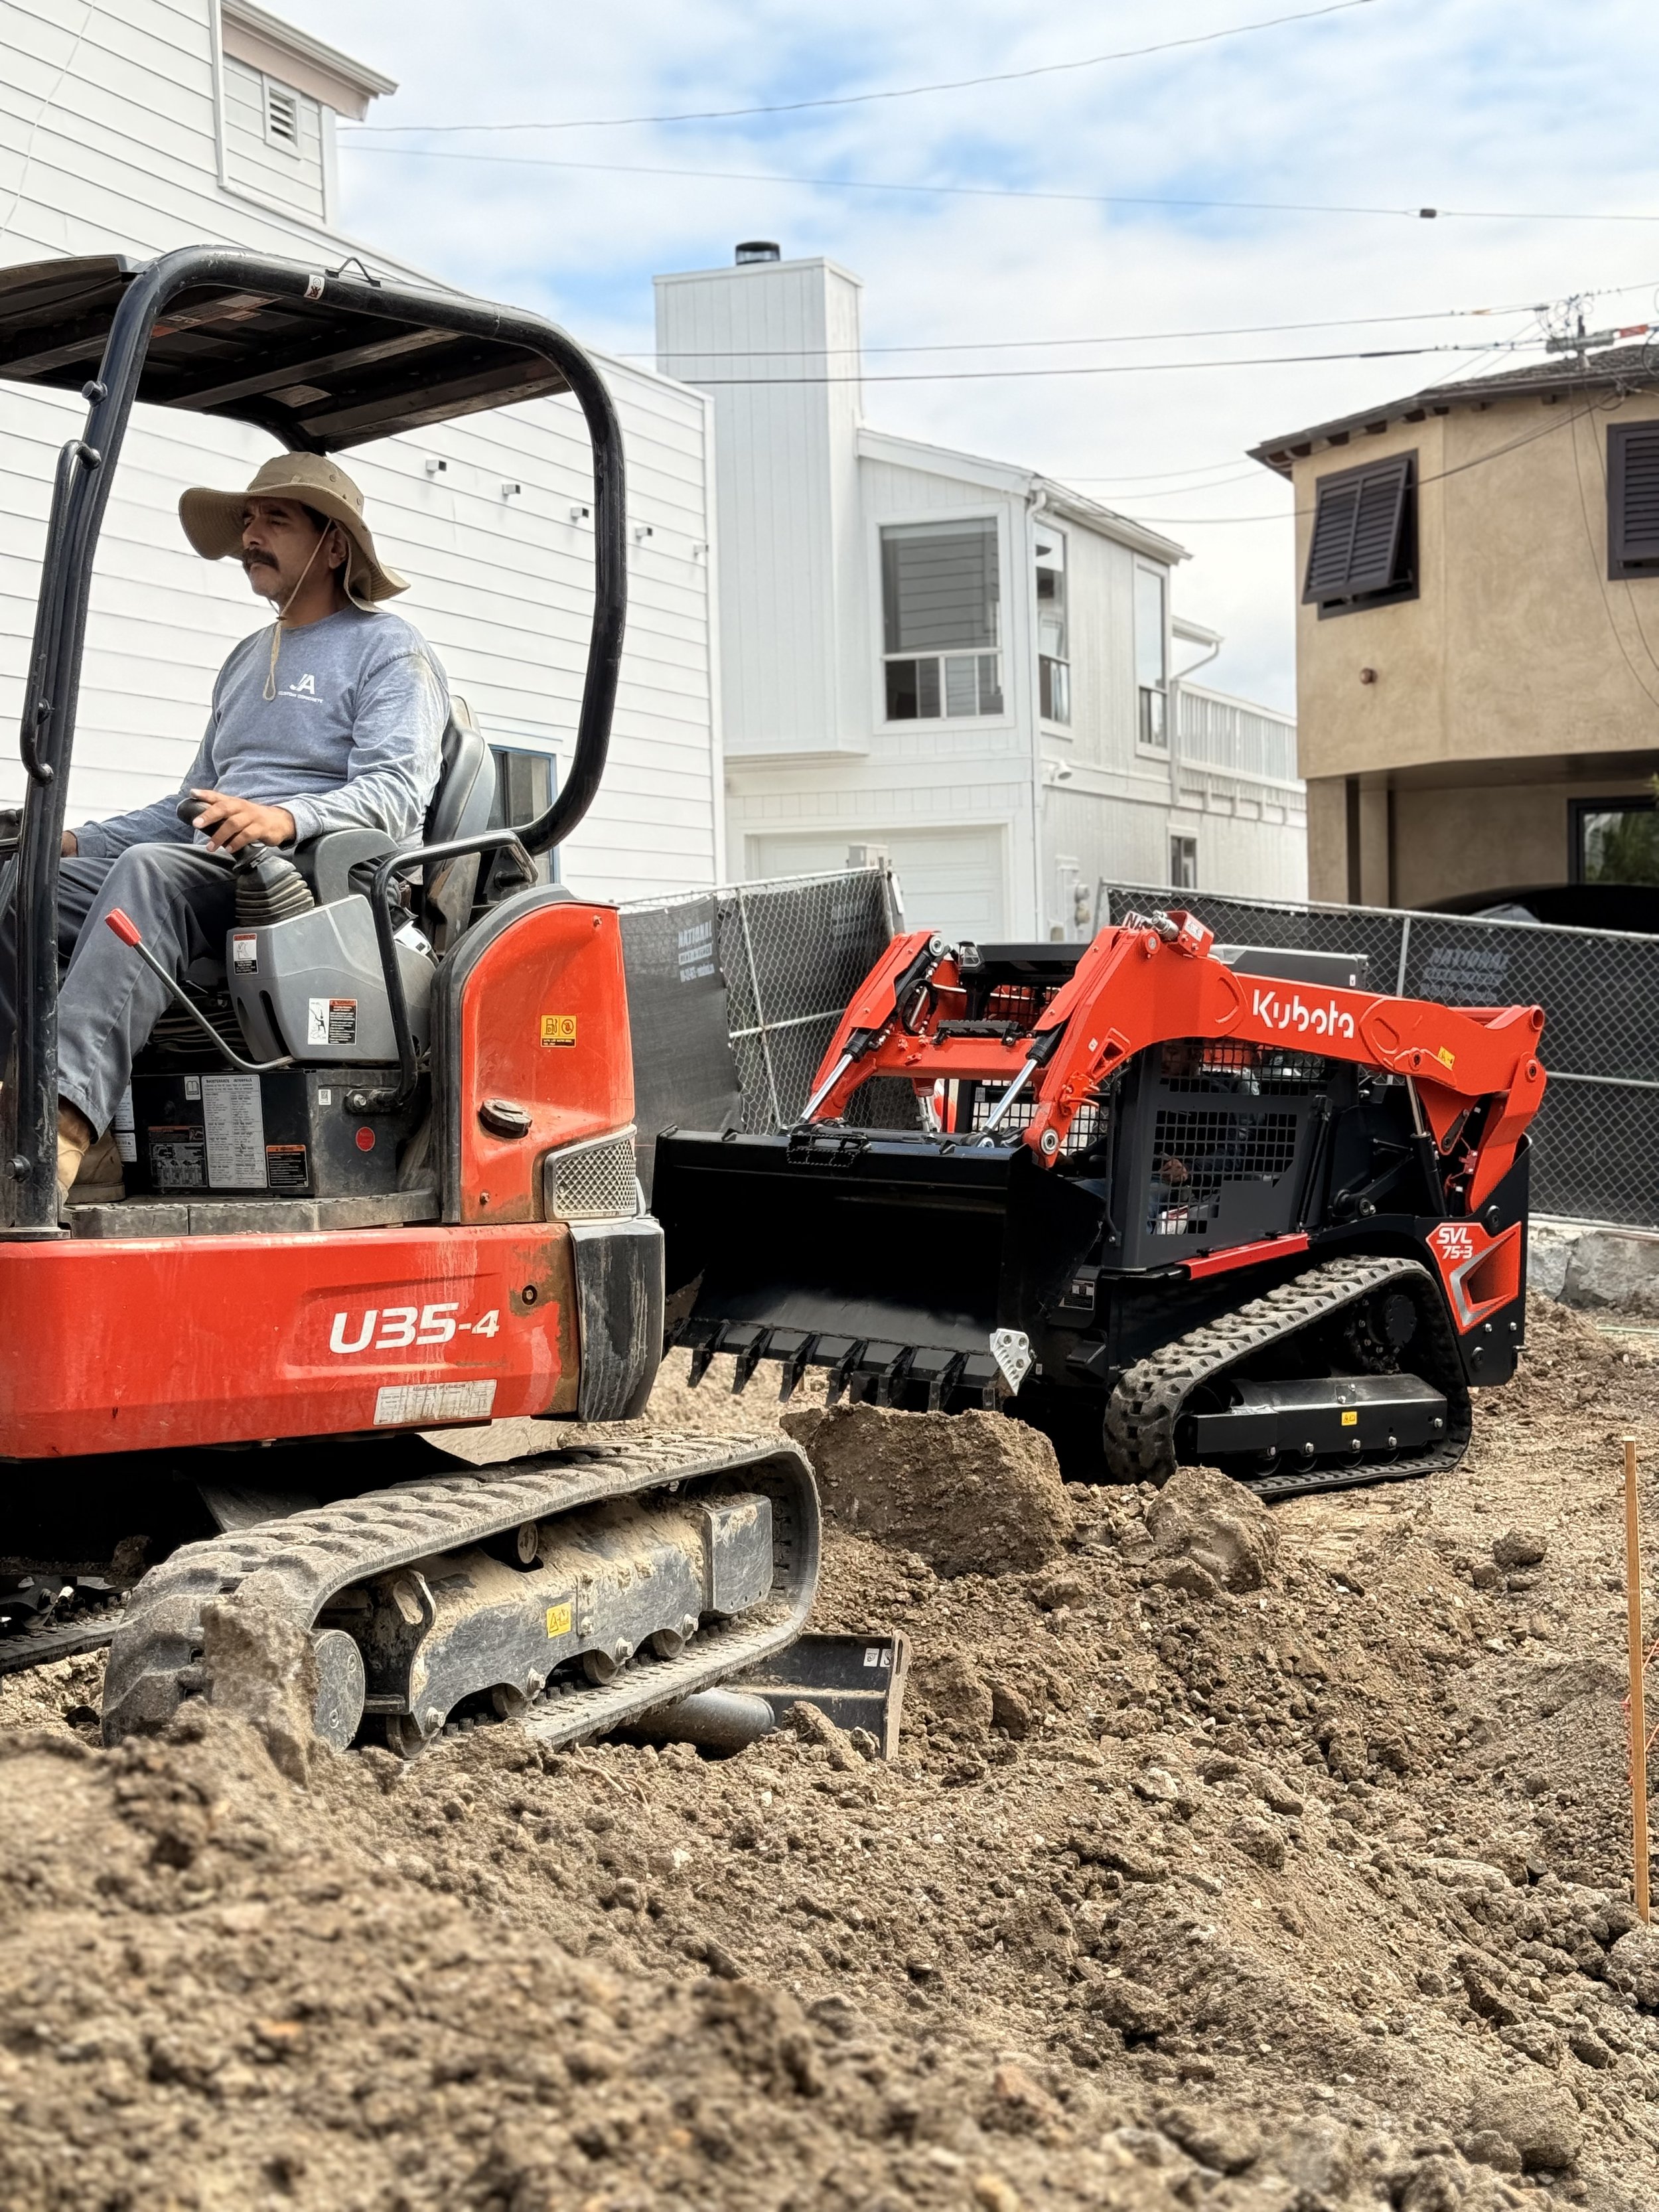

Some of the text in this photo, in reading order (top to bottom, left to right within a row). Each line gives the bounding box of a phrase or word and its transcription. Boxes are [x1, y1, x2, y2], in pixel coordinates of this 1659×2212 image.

[289, 674, 315, 695] JA
[678, 919, 712, 949] NATIONAL
[1252, 989, 1354, 1039] Kubota
[1436, 1227, 1473, 1244] SVL
[1442, 1245, 1473, 1260] 75-3
[329, 1302, 500, 1354] U35-4
